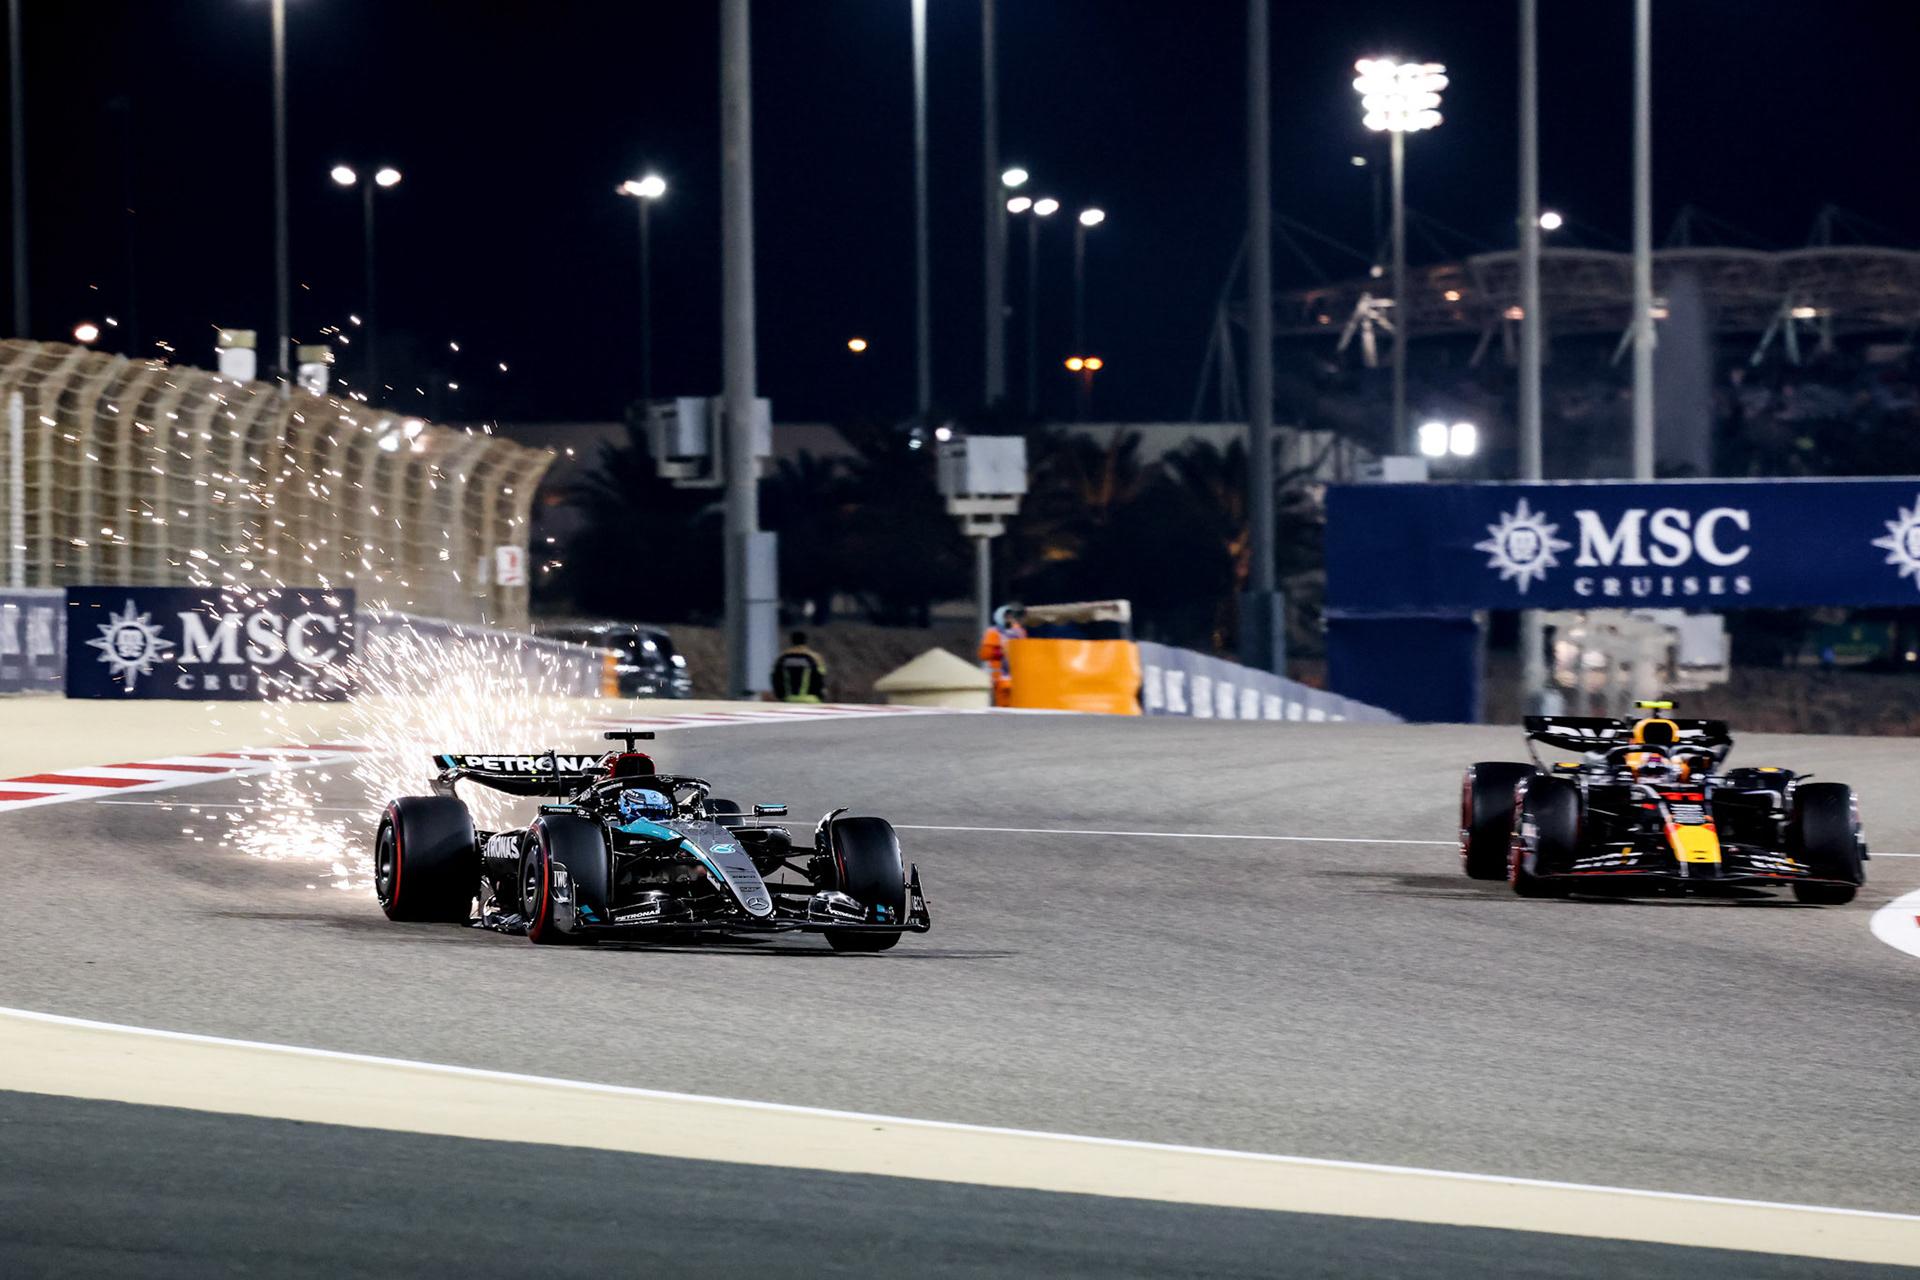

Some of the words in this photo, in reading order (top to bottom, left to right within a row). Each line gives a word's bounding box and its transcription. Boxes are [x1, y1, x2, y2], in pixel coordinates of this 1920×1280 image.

[1573, 507, 1751, 567] MSC
[1573, 575, 1751, 597] CRUISES
[177, 611, 337, 664] MSC
[464, 755, 599, 772] PETRONA
[553, 870, 568, 888] IWC
[614, 909, 661, 921] PETRONAS
